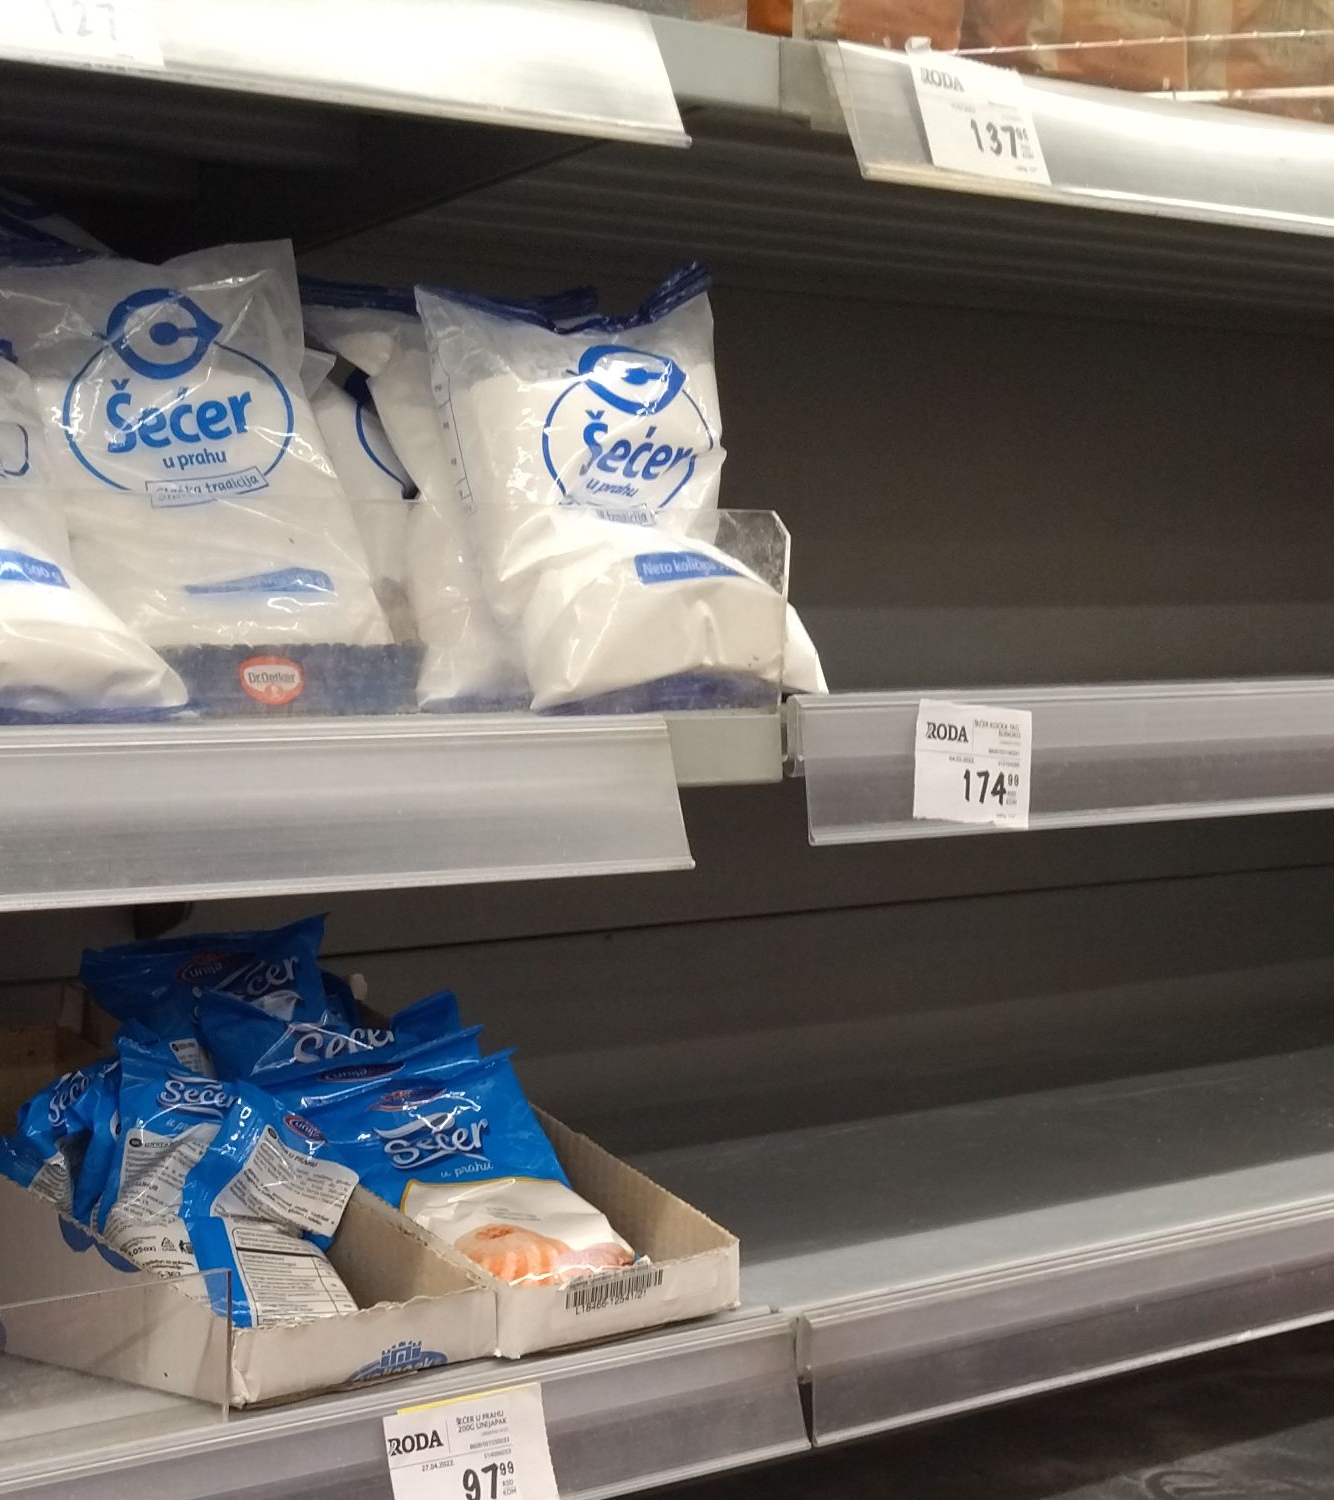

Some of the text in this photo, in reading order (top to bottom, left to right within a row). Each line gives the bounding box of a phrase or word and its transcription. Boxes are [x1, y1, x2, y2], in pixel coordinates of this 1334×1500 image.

[106, 379, 252, 453] Šećer
[179, 446, 227, 471] prahu
[579, 410, 693, 480] Šećer
[926, 722, 968, 742] RODA
[964, 769, 1006, 805] 174
[388, 1430, 444, 1456] RODA
